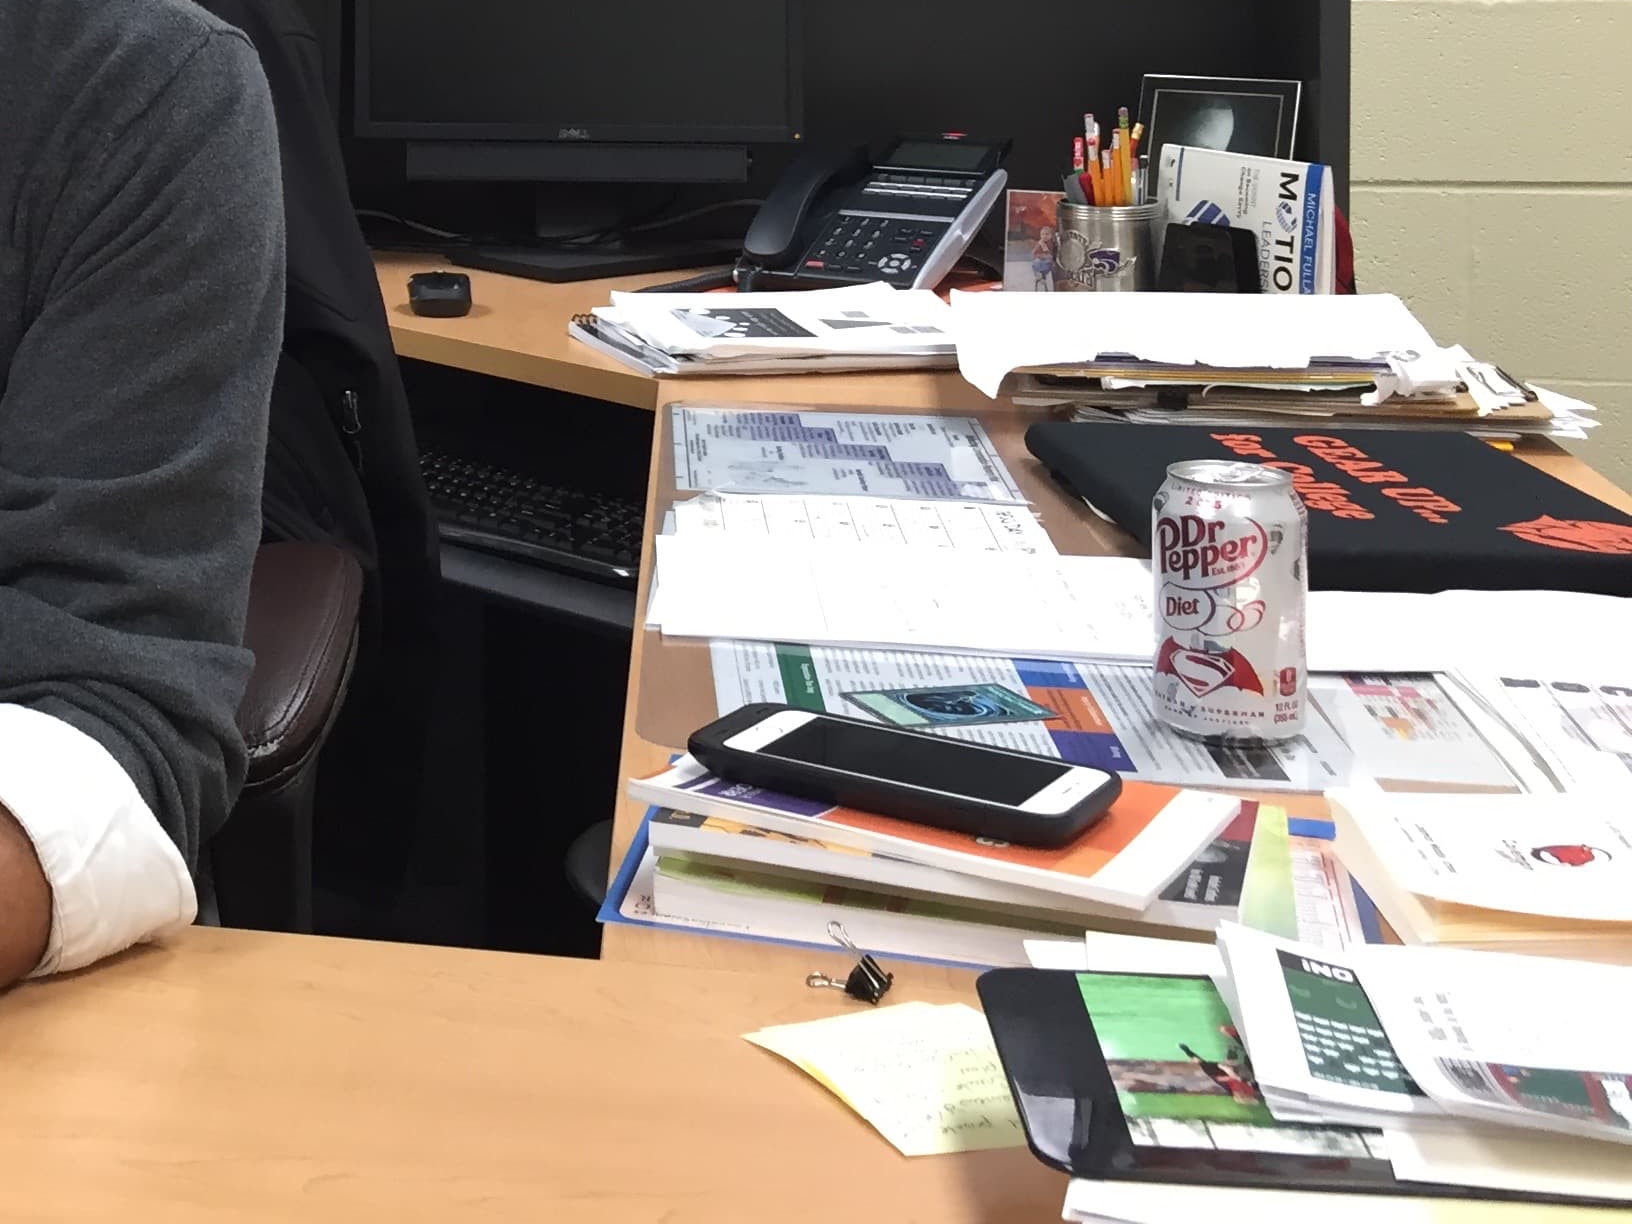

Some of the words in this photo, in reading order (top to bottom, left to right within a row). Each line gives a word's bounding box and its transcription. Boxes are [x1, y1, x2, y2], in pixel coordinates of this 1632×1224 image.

[1304, 192, 1317, 250] MICHAEL
[1261, 221, 1272, 293] LEADERS
[1300, 254, 1314, 294] FULLA
[1292, 433, 1409, 484] GEAR
[1264, 461, 1376, 522] College
[1157, 517, 1258, 582] Pepper
[1179, 514, 1226, 548] Dr
[1165, 596, 1200, 617] Diet
[1200, 705, 1266, 719] SUPERMAN
